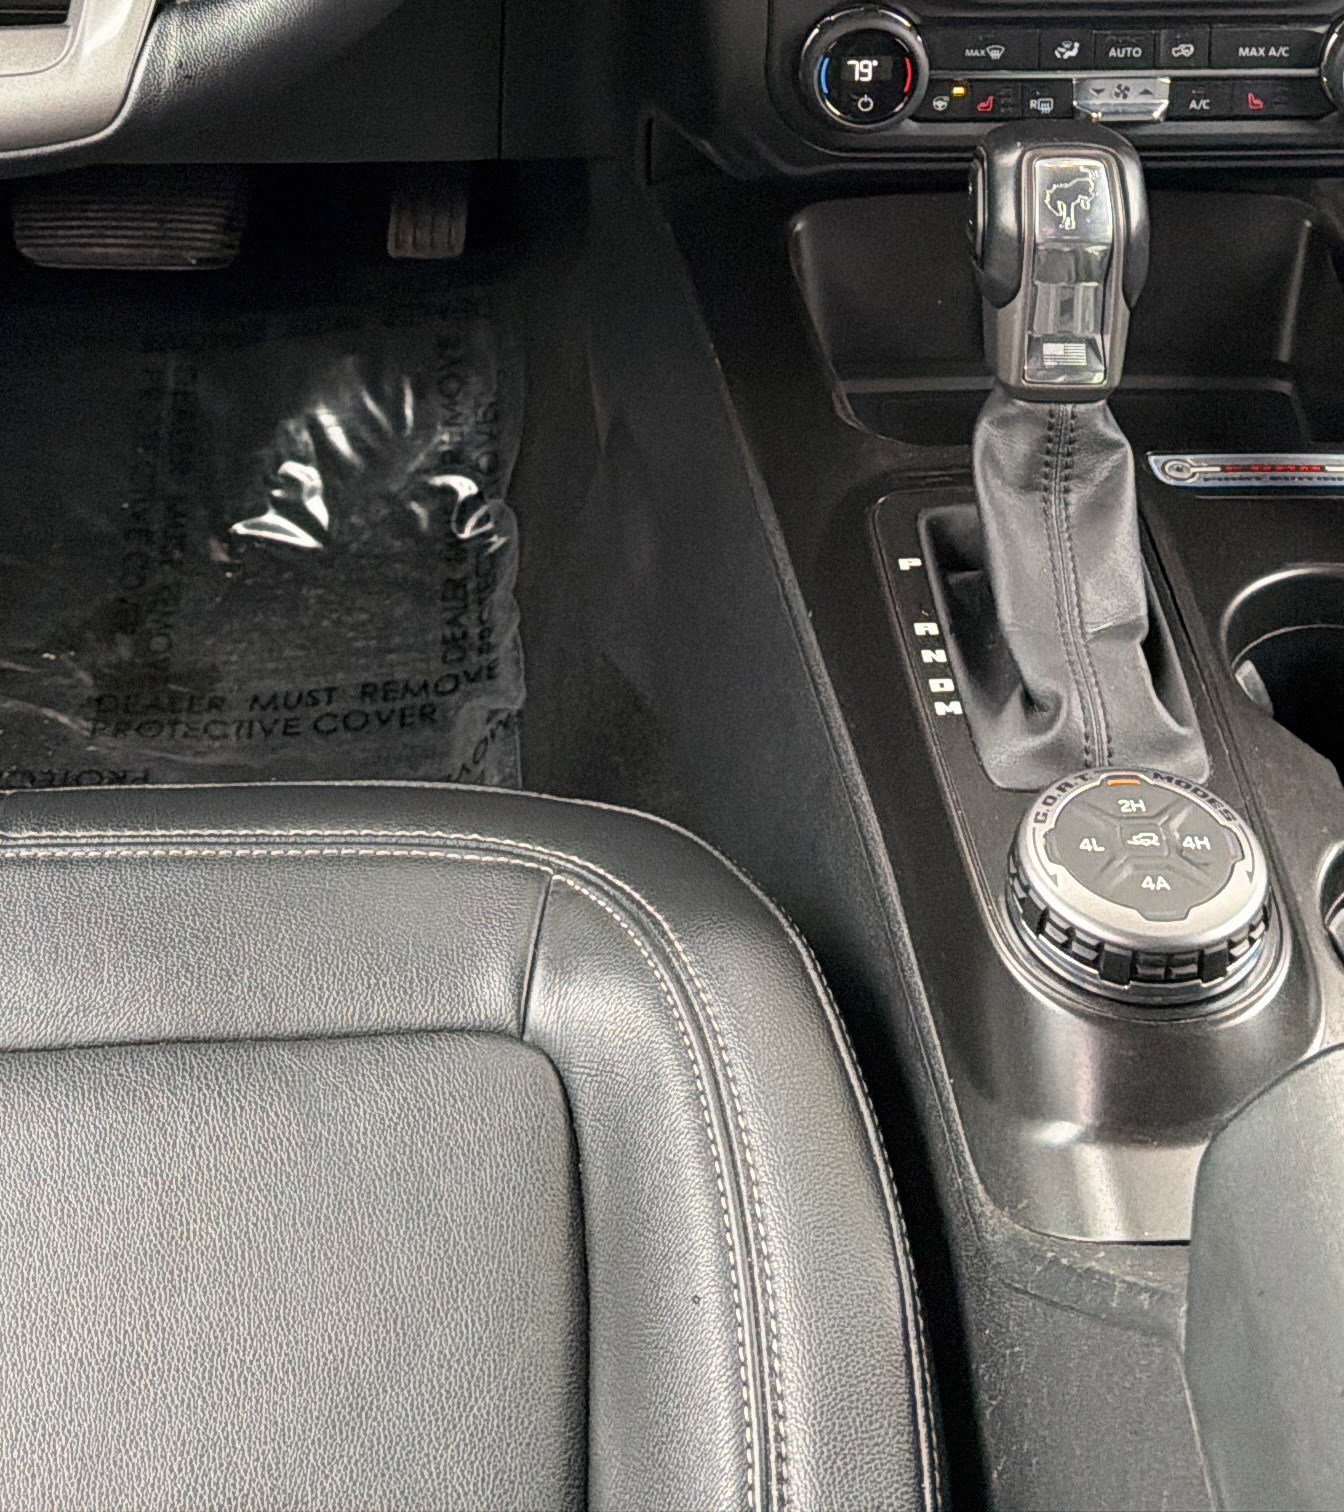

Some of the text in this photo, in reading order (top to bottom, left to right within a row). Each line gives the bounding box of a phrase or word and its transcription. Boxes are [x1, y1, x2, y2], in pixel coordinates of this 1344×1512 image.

[965, 49, 985, 57] MAX
[1108, 47, 1142, 58] AUTO
[1238, 46, 1290, 58] MAX A/C
[1189, 99, 1211, 110] A/C
[898, 558, 922, 570] P
[921, 649, 947, 663] N
[248, 686, 338, 711] MUST
[359, 665, 498, 705] REMOVE
[934, 701, 963, 715] M
[311, 702, 439, 737] COVER
[1152, 772, 1237, 823] MODES
[1117, 799, 1146, 813] 2H
[1079, 838, 1105, 852] 4L
[1182, 836, 1212, 851] 4H
[1141, 876, 1171, 891] 4A
